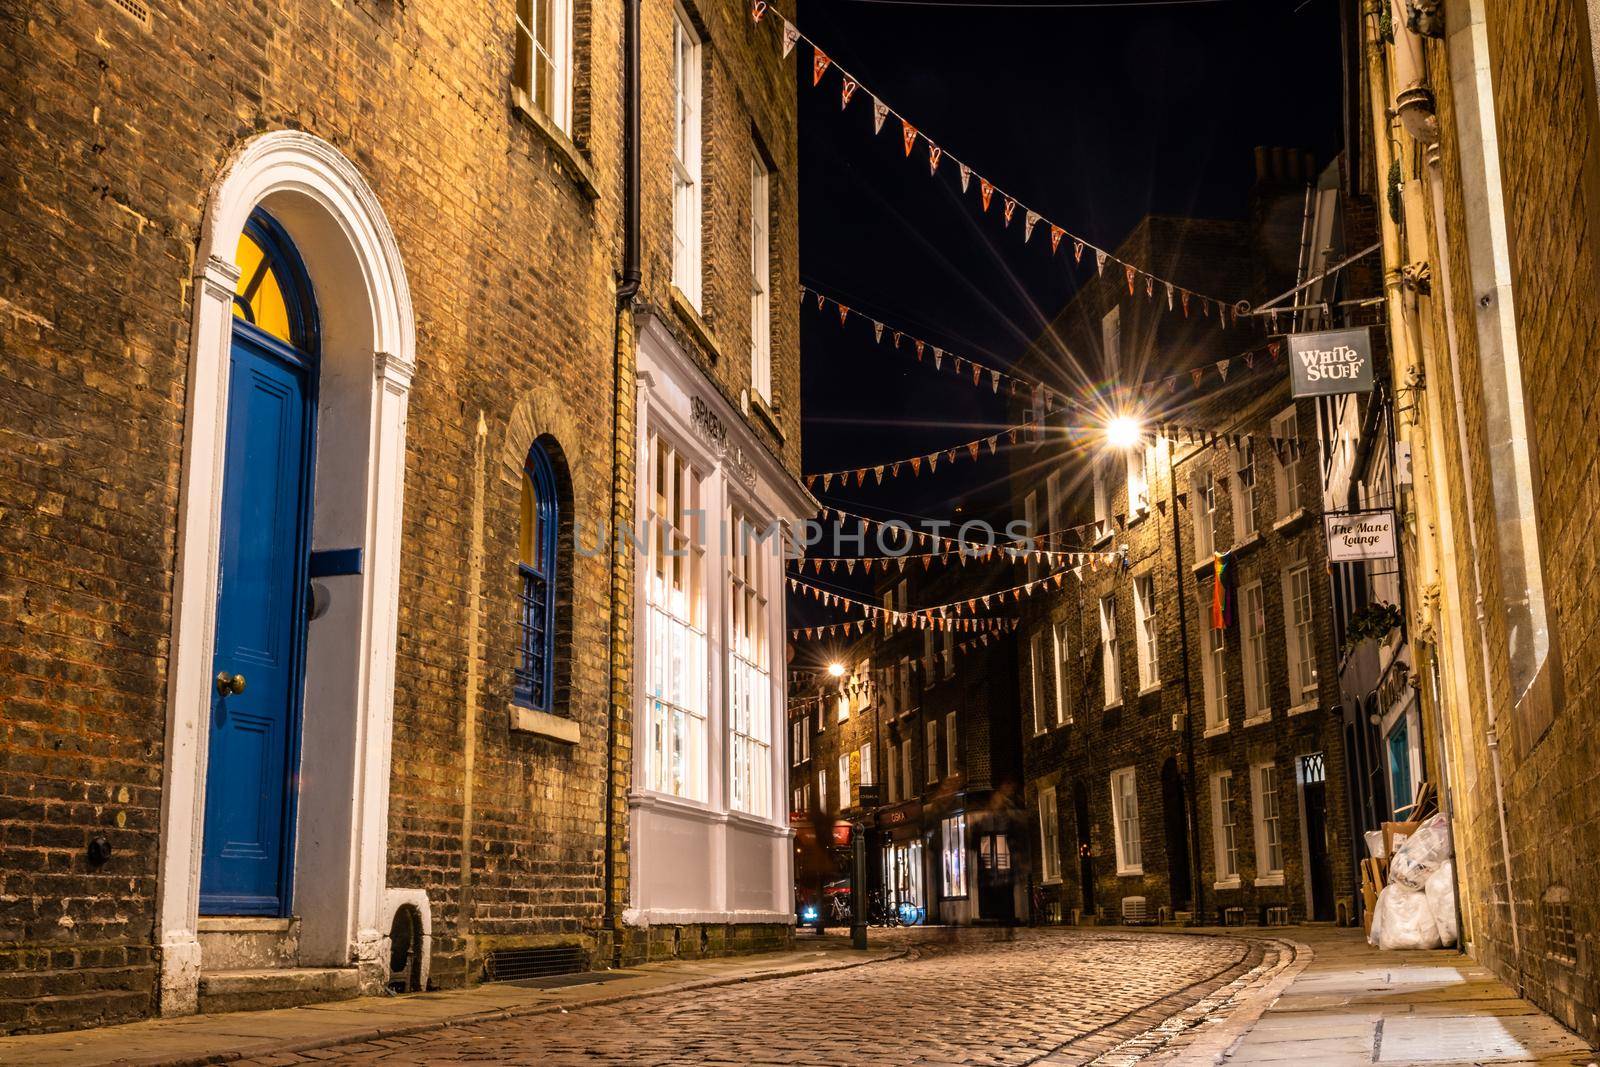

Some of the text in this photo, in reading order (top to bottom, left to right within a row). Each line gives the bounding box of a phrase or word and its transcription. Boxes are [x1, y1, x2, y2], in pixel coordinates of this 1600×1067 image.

[1331, 522, 1389, 535] The Mane
[1342, 534, 1380, 548] Lounge
